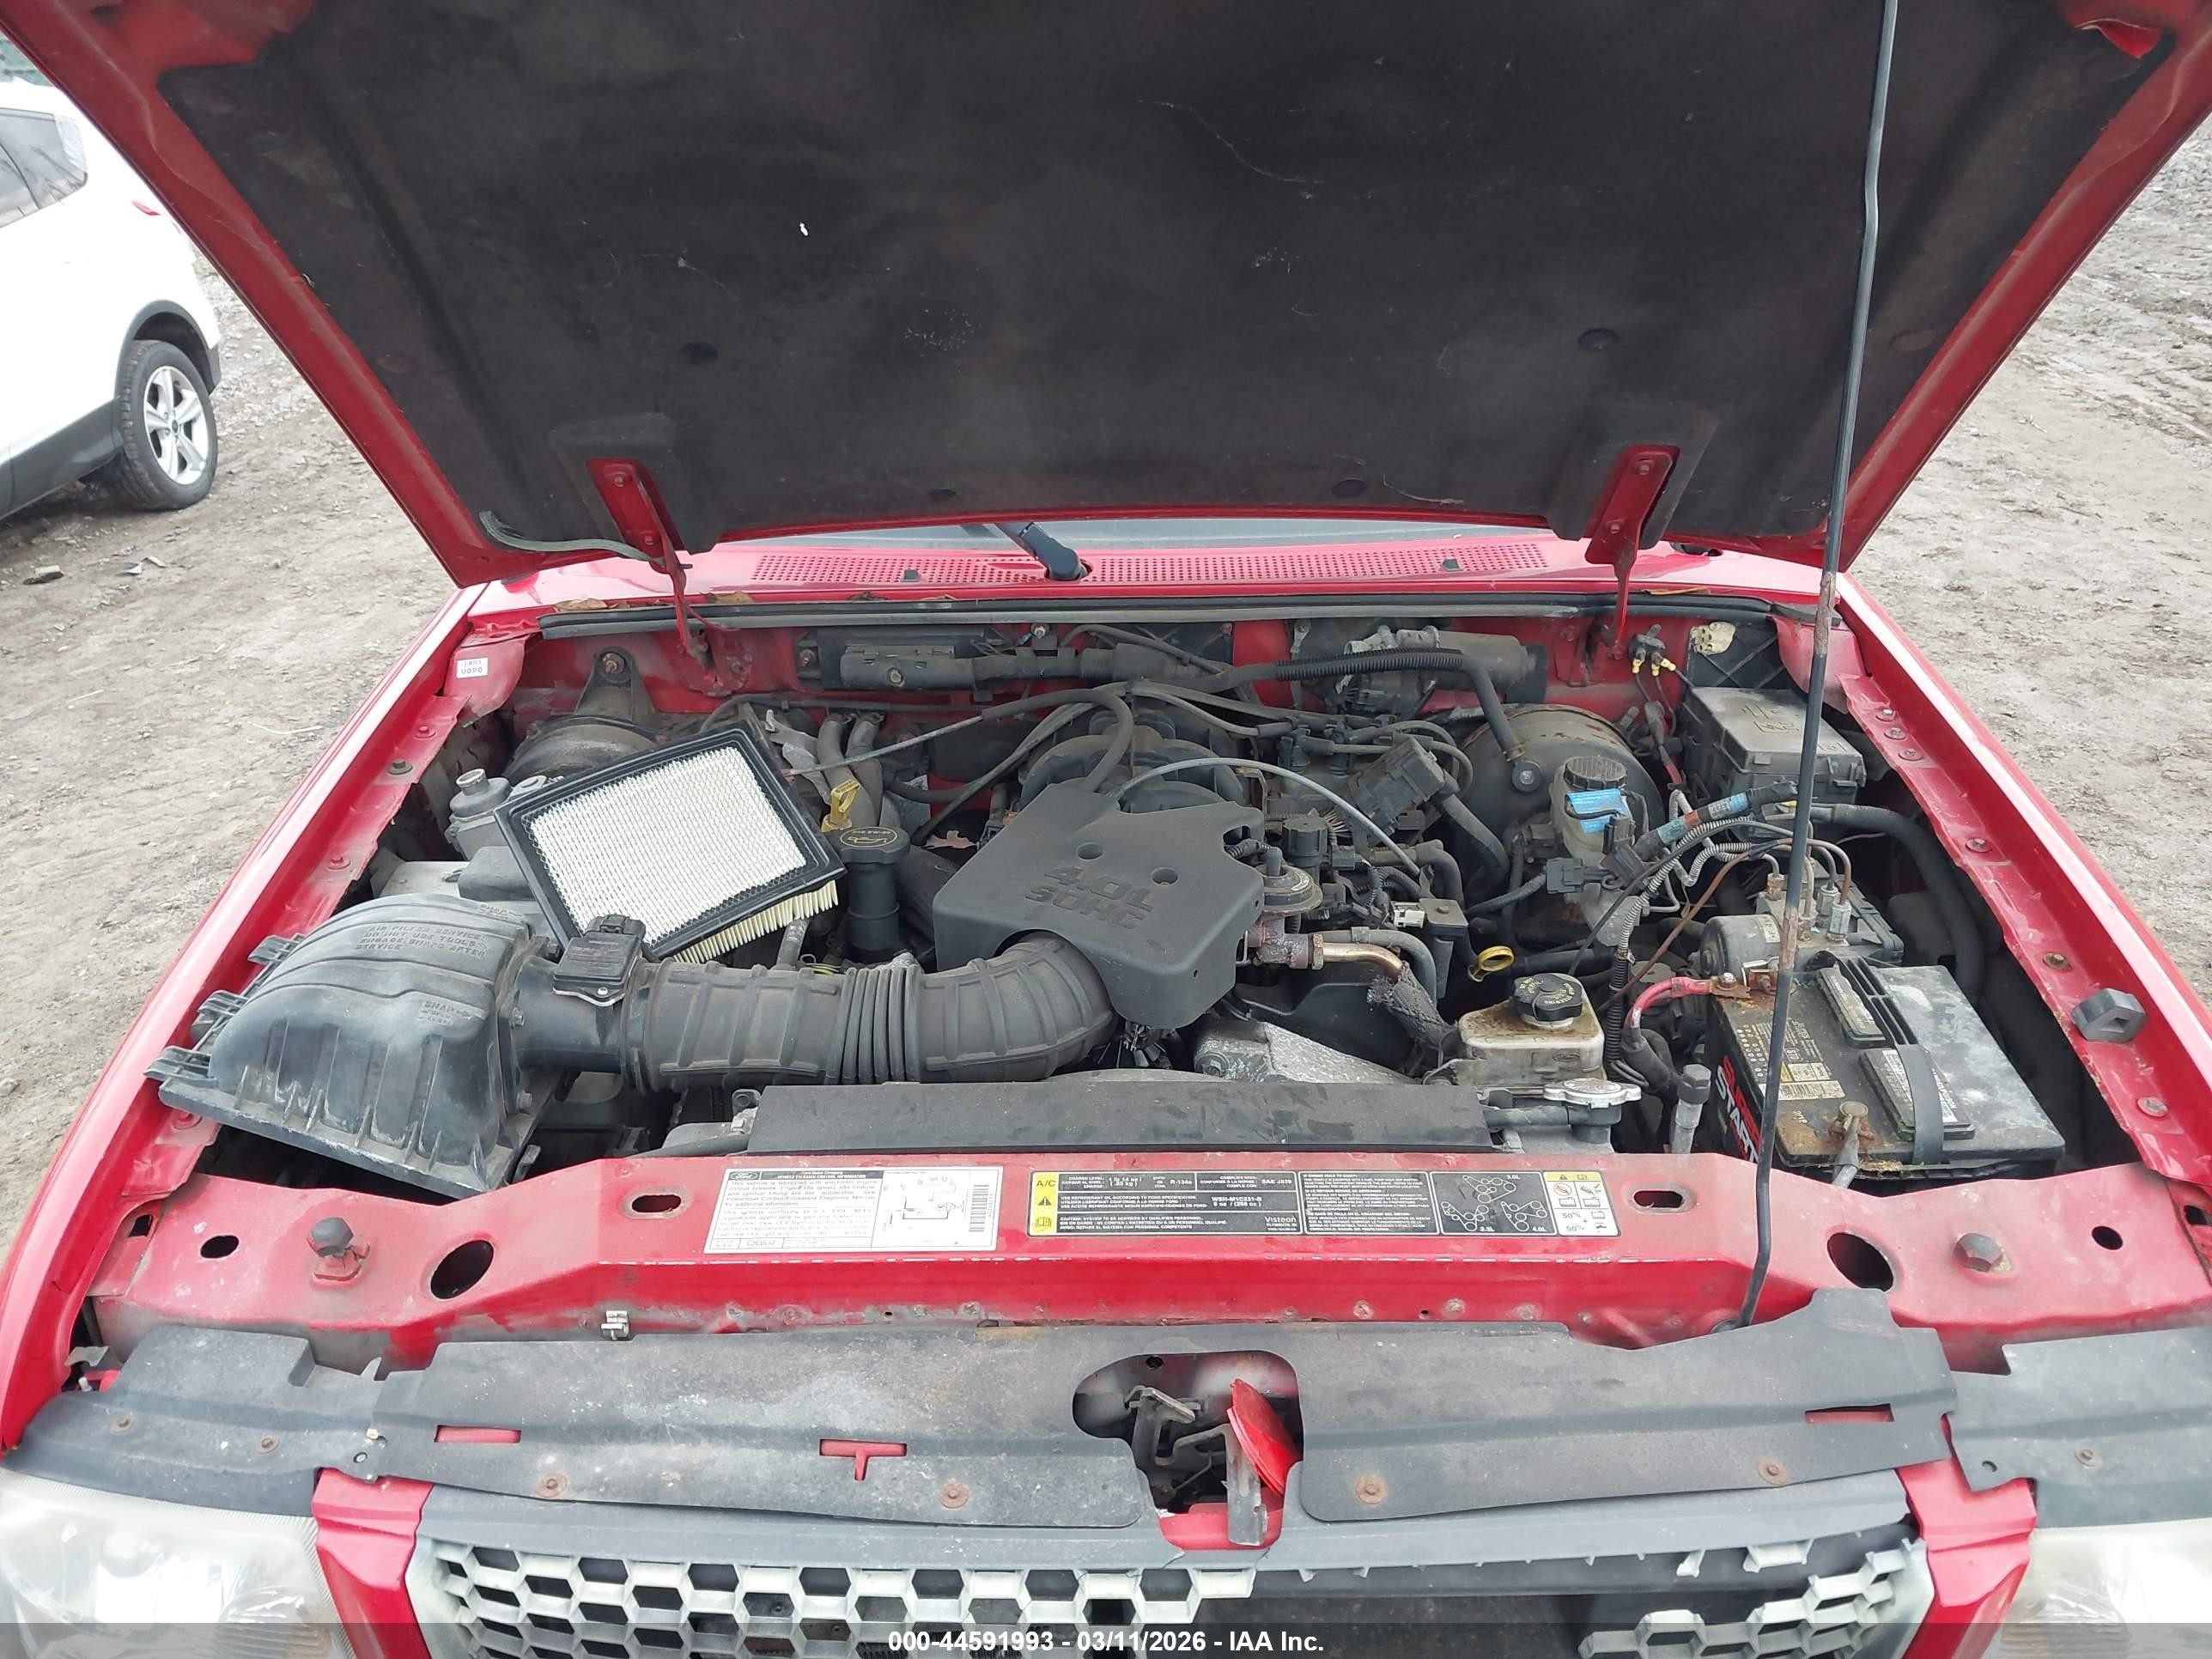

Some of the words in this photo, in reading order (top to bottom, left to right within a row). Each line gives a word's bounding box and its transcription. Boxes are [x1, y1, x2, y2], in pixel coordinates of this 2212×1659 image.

[1043, 866, 1153, 913] 4.0L
[1024, 885, 1146, 929] SOHC
[424, 1000, 455, 1013] SNAP
[1036, 1179, 1056, 1188] A/C
